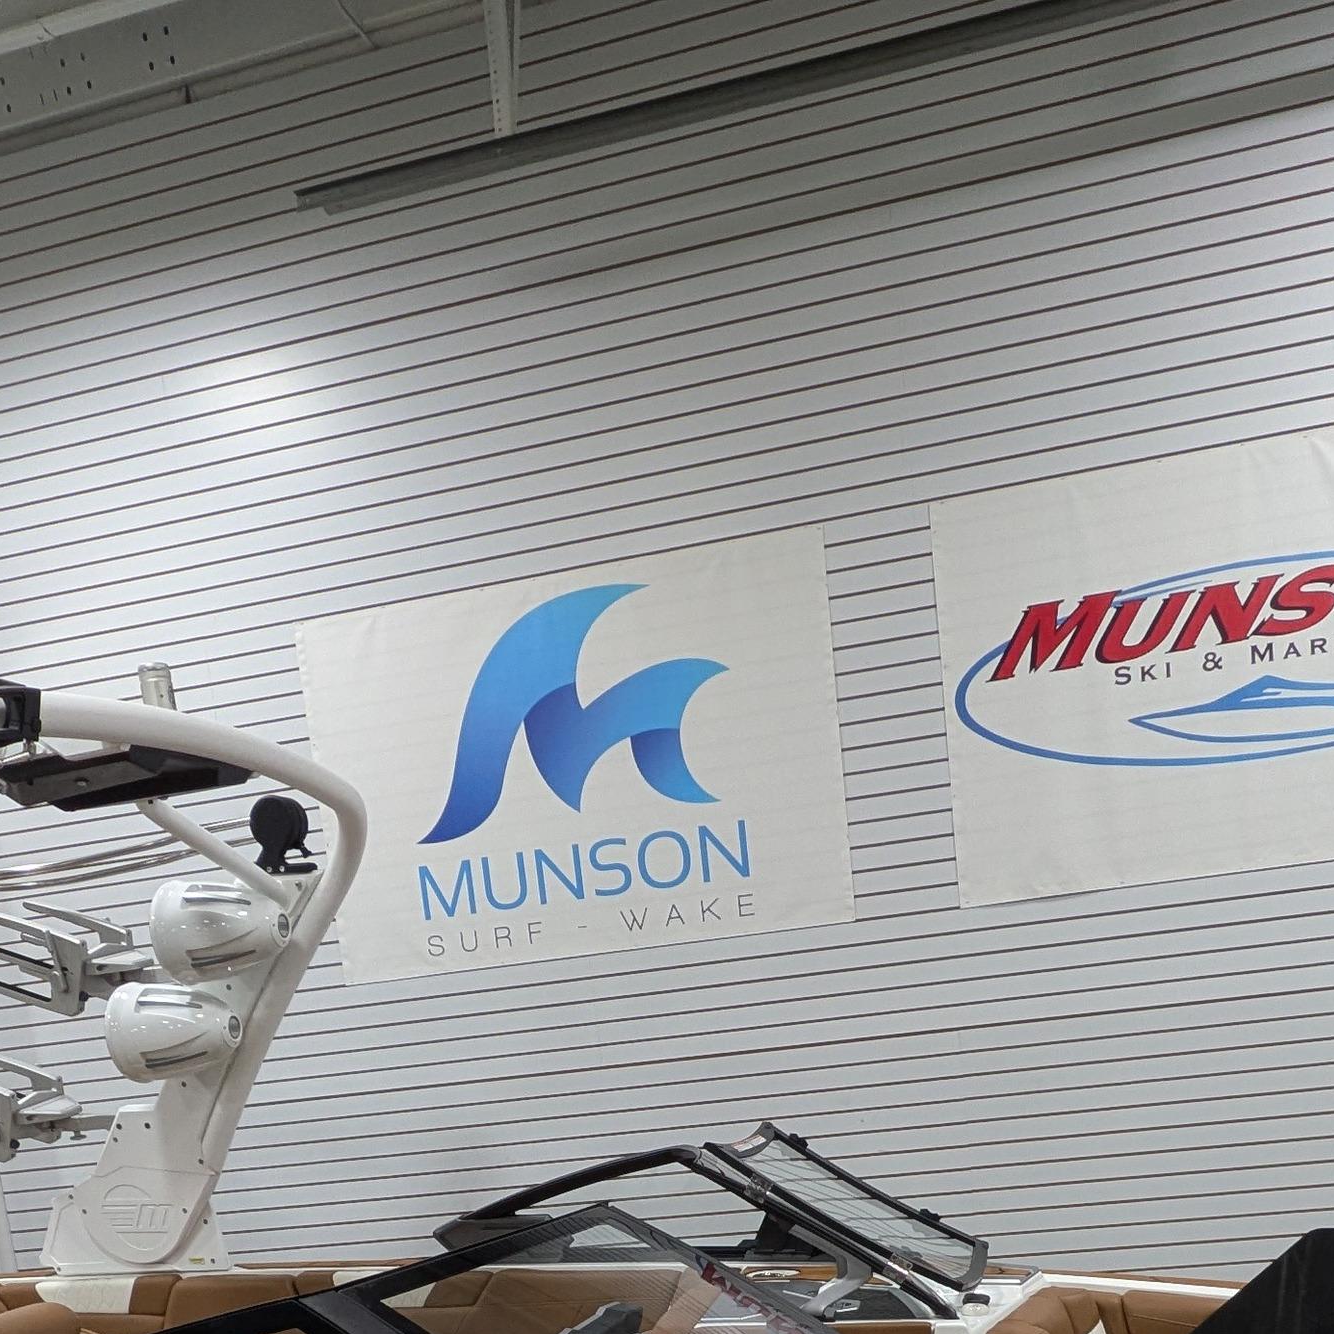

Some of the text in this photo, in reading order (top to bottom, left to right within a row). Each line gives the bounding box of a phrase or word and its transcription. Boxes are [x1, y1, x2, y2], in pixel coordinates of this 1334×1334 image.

[1113, 661, 1174, 686] SKI
[1202, 651, 1223, 671] &
[417, 820, 750, 921] MUNSON
[426, 921, 543, 957] SURF
[619, 892, 756, 932] WAKE
